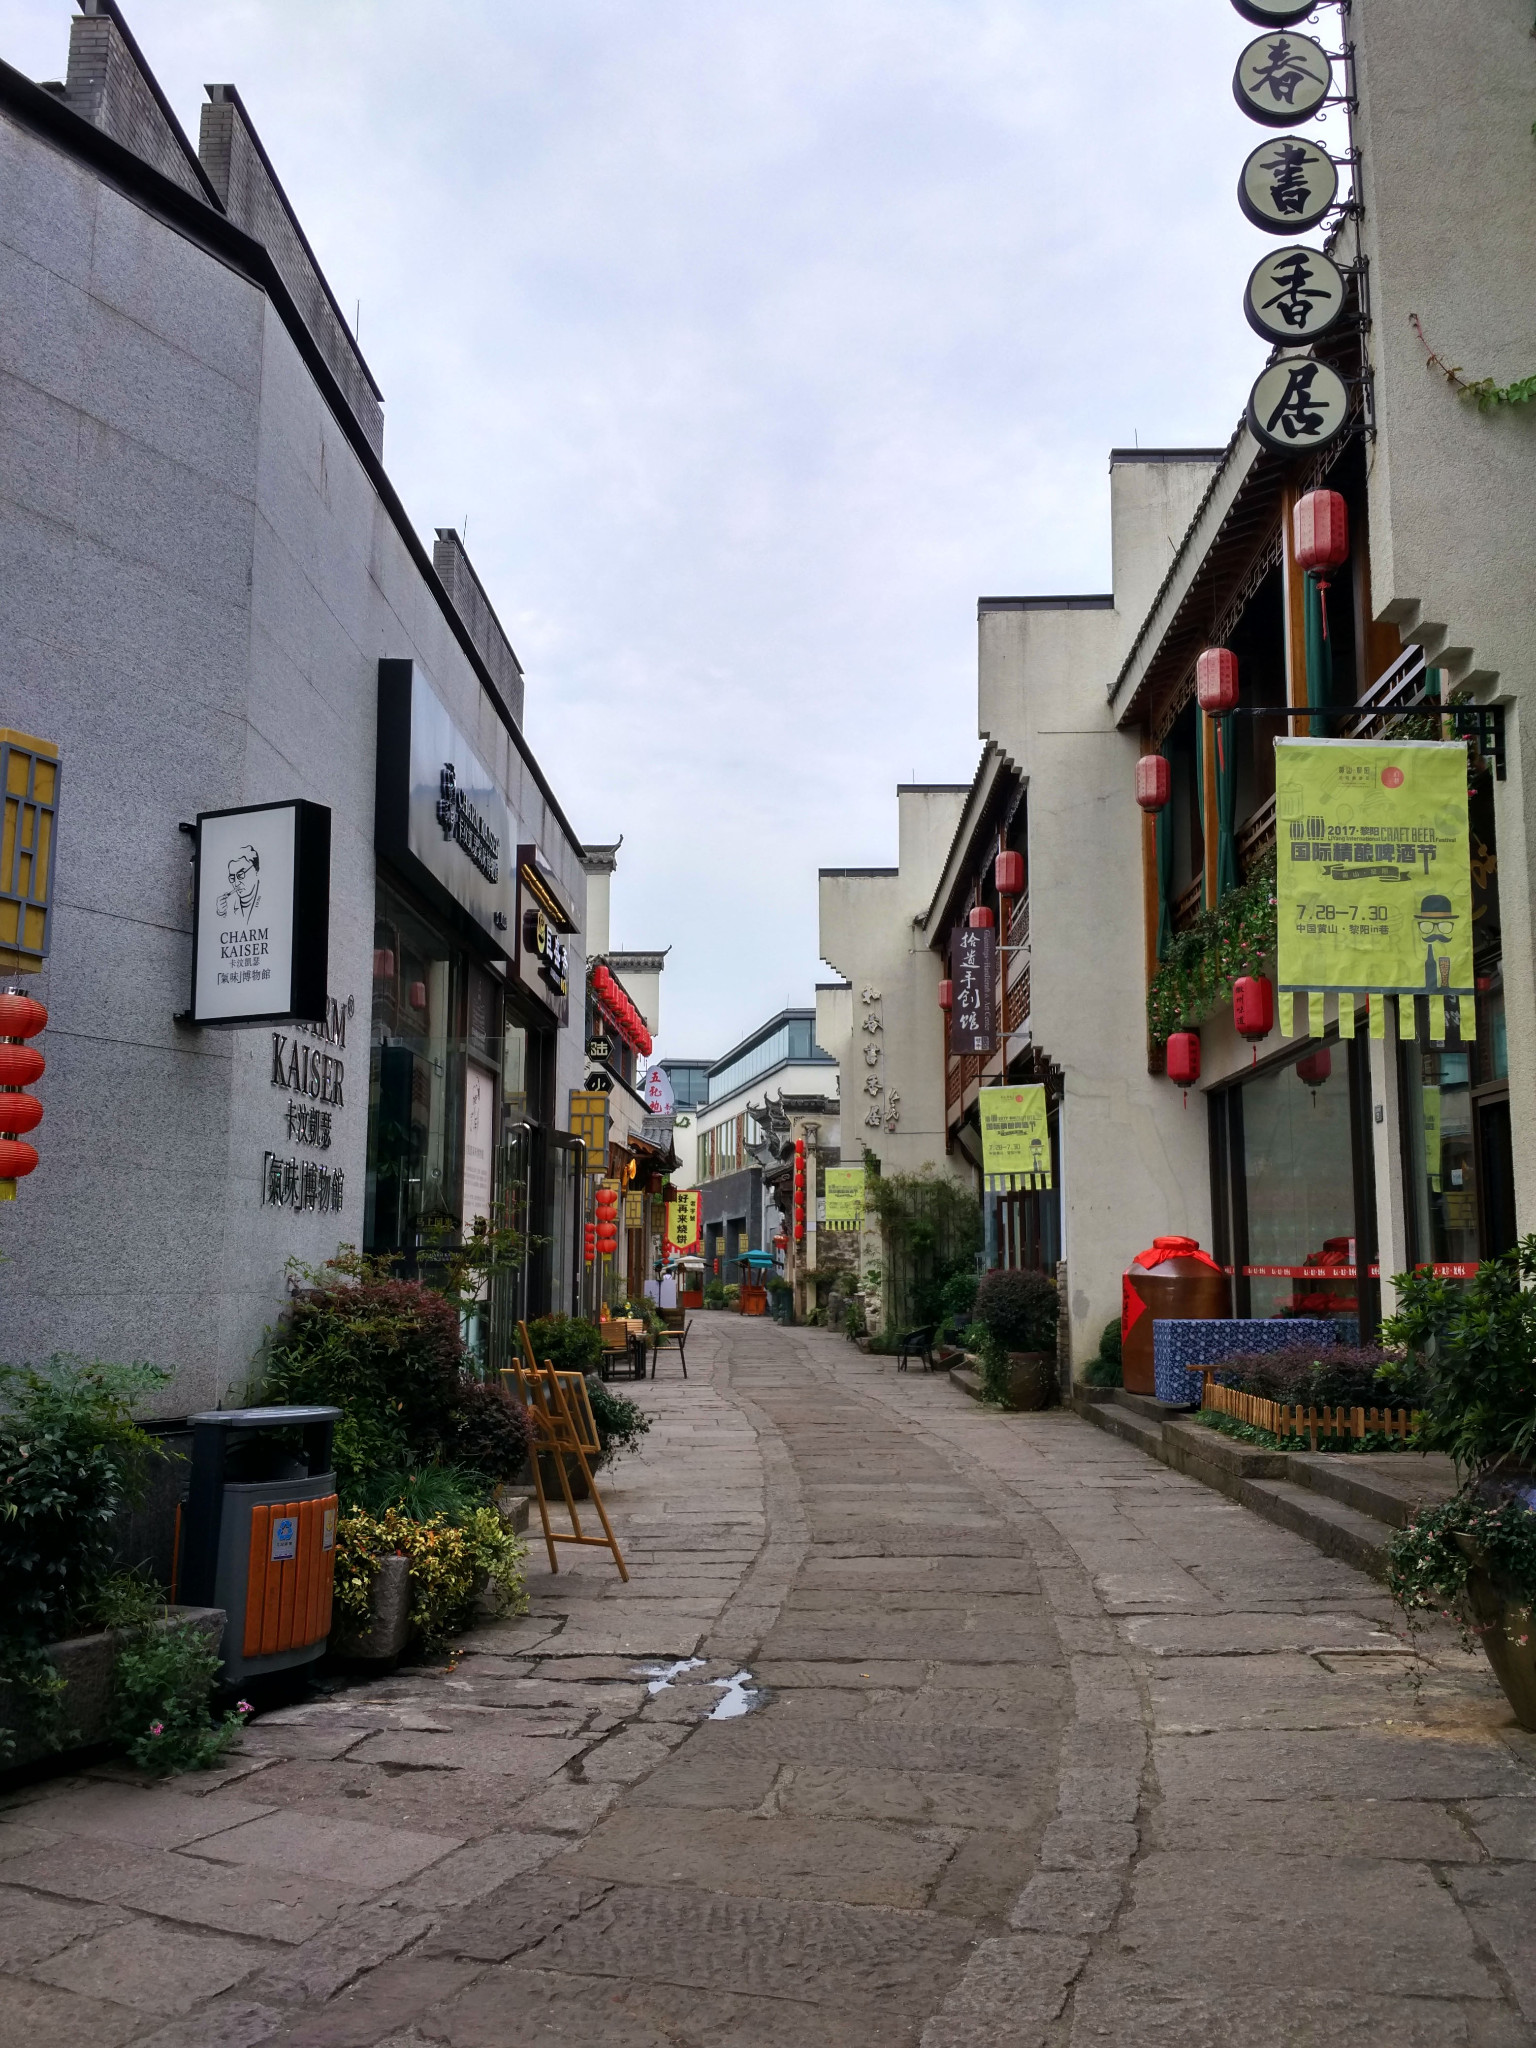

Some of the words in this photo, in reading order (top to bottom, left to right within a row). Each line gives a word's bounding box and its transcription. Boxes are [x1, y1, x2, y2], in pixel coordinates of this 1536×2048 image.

[1381, 827, 1410, 842] CRAFT
[1412, 828, 1435, 842] BEER
[1291, 842, 1437, 875] 国际精酿啤酒节
[220, 928, 269, 944] CHARM
[220, 942, 269, 959] KAISER
[270, 1032, 344, 1107] KAISER
